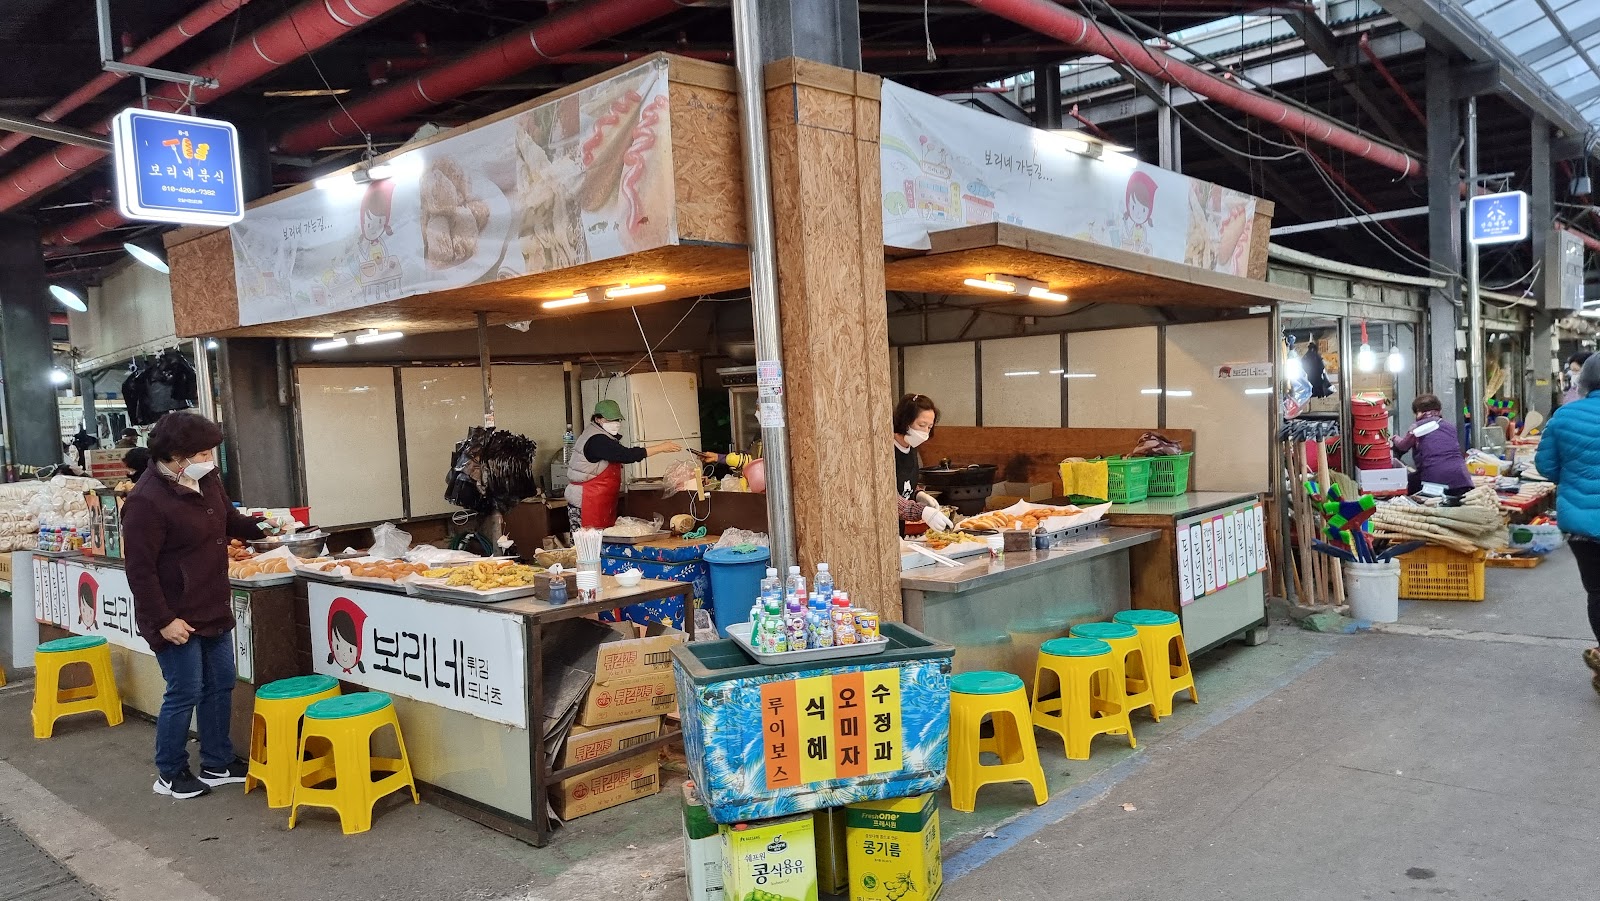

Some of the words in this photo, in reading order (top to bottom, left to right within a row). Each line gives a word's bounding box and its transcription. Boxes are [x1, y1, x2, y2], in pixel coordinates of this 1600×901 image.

[984, 150, 1013, 172] 보리네
[149, 163, 224, 184] 보리네분식
[282, 222, 302, 241] 보리네
[1232, 367, 1257, 377] 보리네
[373, 627, 465, 699] 보리네
[467, 656, 488, 680] 튀김
[467, 681, 503, 706] 도너츠
[614, 685, 653, 707] 튀김가루
[804, 696, 828, 761] 식혜
[838, 687, 860, 766] 오미자
[871, 684, 893, 761] 수정과
[767, 697, 789, 782] 루이보스
[590, 768, 631, 795] 튀김가루
[872, 819, 897, 829] 프레시원
[863, 840, 902, 858] 콩기름
[751, 859, 805, 885] 콩식용유
